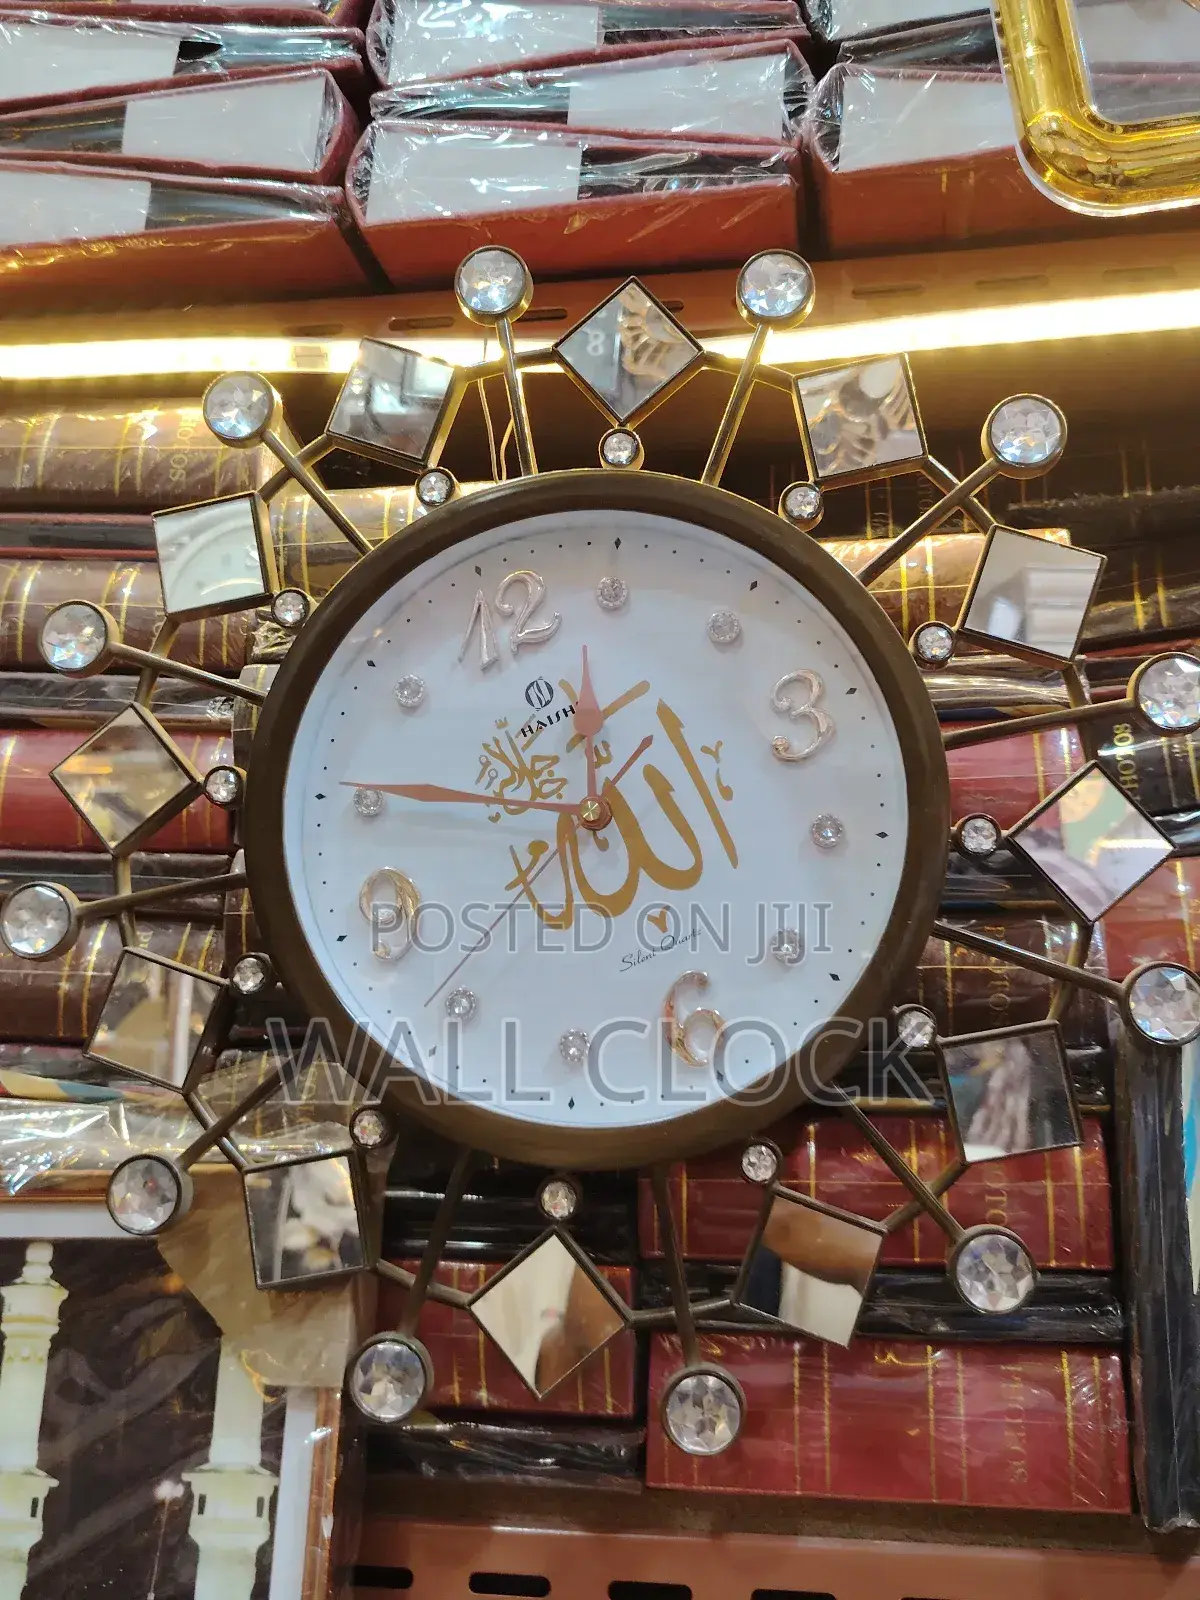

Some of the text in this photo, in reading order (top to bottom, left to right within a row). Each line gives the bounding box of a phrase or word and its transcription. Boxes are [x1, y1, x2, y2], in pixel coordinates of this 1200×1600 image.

[458, 570, 561, 670] 12
[520, 701, 578, 738] HAISH
[771, 668, 836, 763] 3
[359, 867, 421, 961] 9
[619, 948, 657, 973] Silent
[664, 970, 727, 1068] 6
